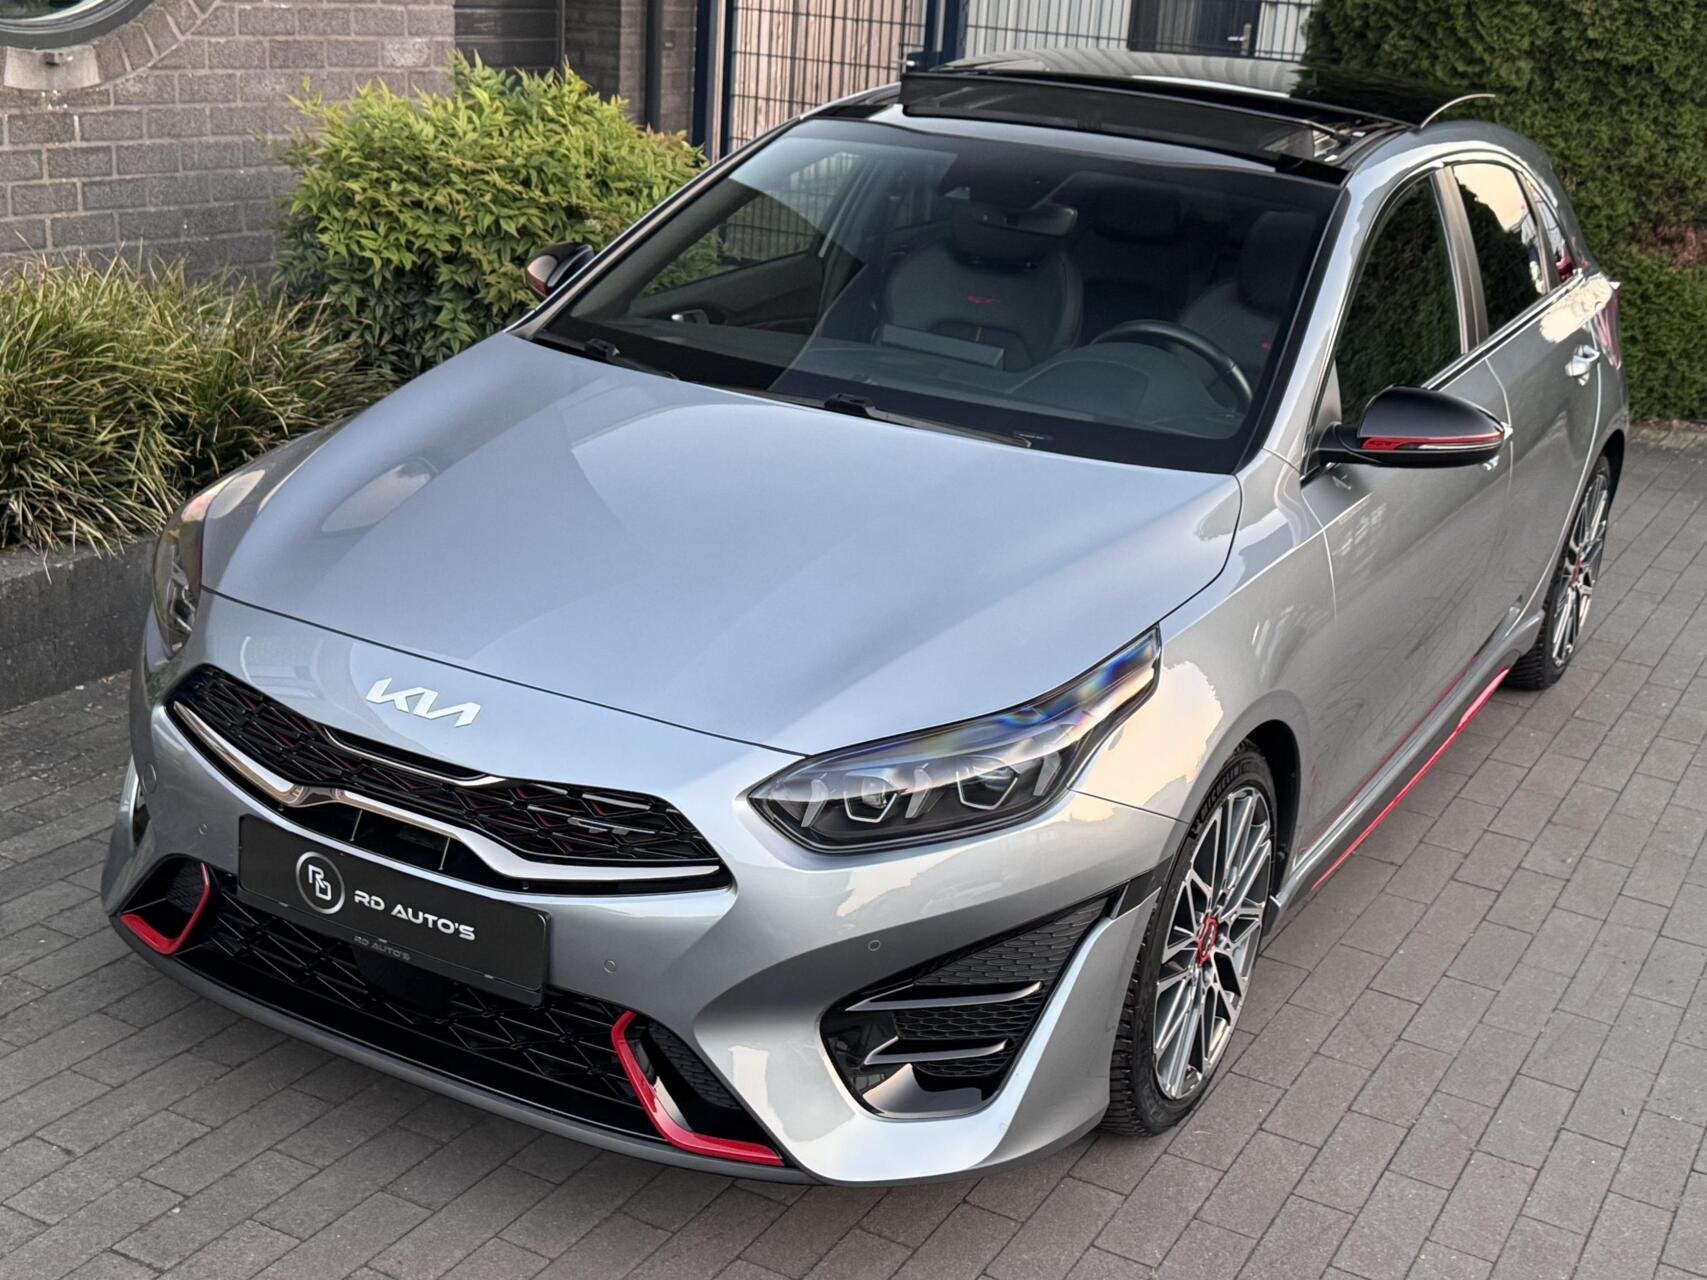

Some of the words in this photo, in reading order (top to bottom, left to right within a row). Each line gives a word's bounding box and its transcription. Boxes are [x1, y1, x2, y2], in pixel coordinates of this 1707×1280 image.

[365, 677, 481, 728] KIA
[353, 890, 385, 911] RD
[391, 903, 476, 941] AUTO'S
[353, 935, 370, 946] RD
[372, 941, 411, 961] AUTO'S
